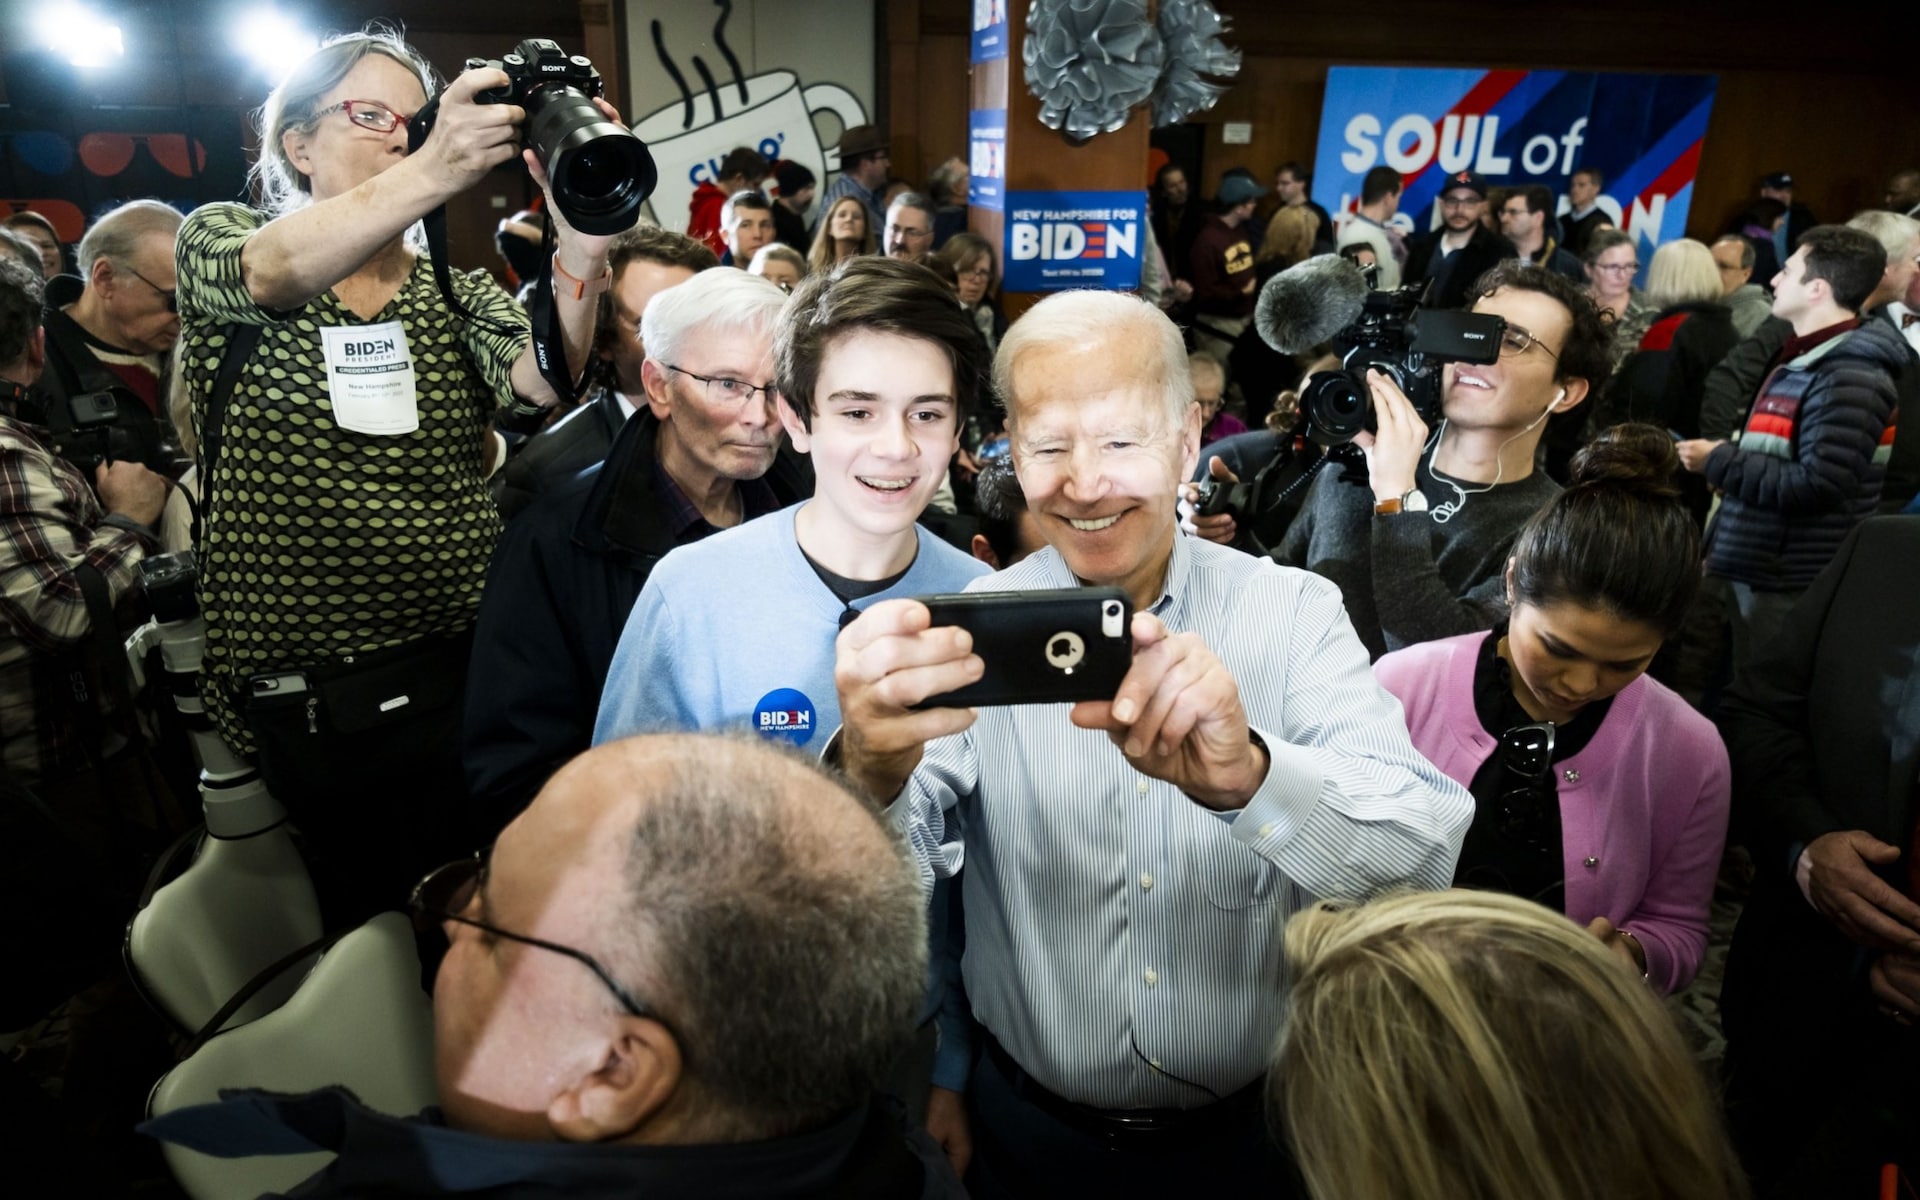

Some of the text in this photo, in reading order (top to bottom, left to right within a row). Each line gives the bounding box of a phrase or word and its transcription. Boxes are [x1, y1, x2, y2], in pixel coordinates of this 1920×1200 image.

[1341, 114, 1588, 175] SOUL of
[1013, 208, 1137, 220] NEW HAMPSHIRE FOR
[1012, 223, 1137, 260] BIDEN
[1463, 332, 1485, 340] SONY
[344, 338, 395, 356] BIDEN
[346, 354, 396, 363] PRESIDENT
[536, 341, 549, 370] SONY
[387, 363, 406, 371] PRESS
[366, 381, 401, 390] Hampshire
[70, 671, 88, 703] EOS
[760, 710, 809, 726] BIDEN
